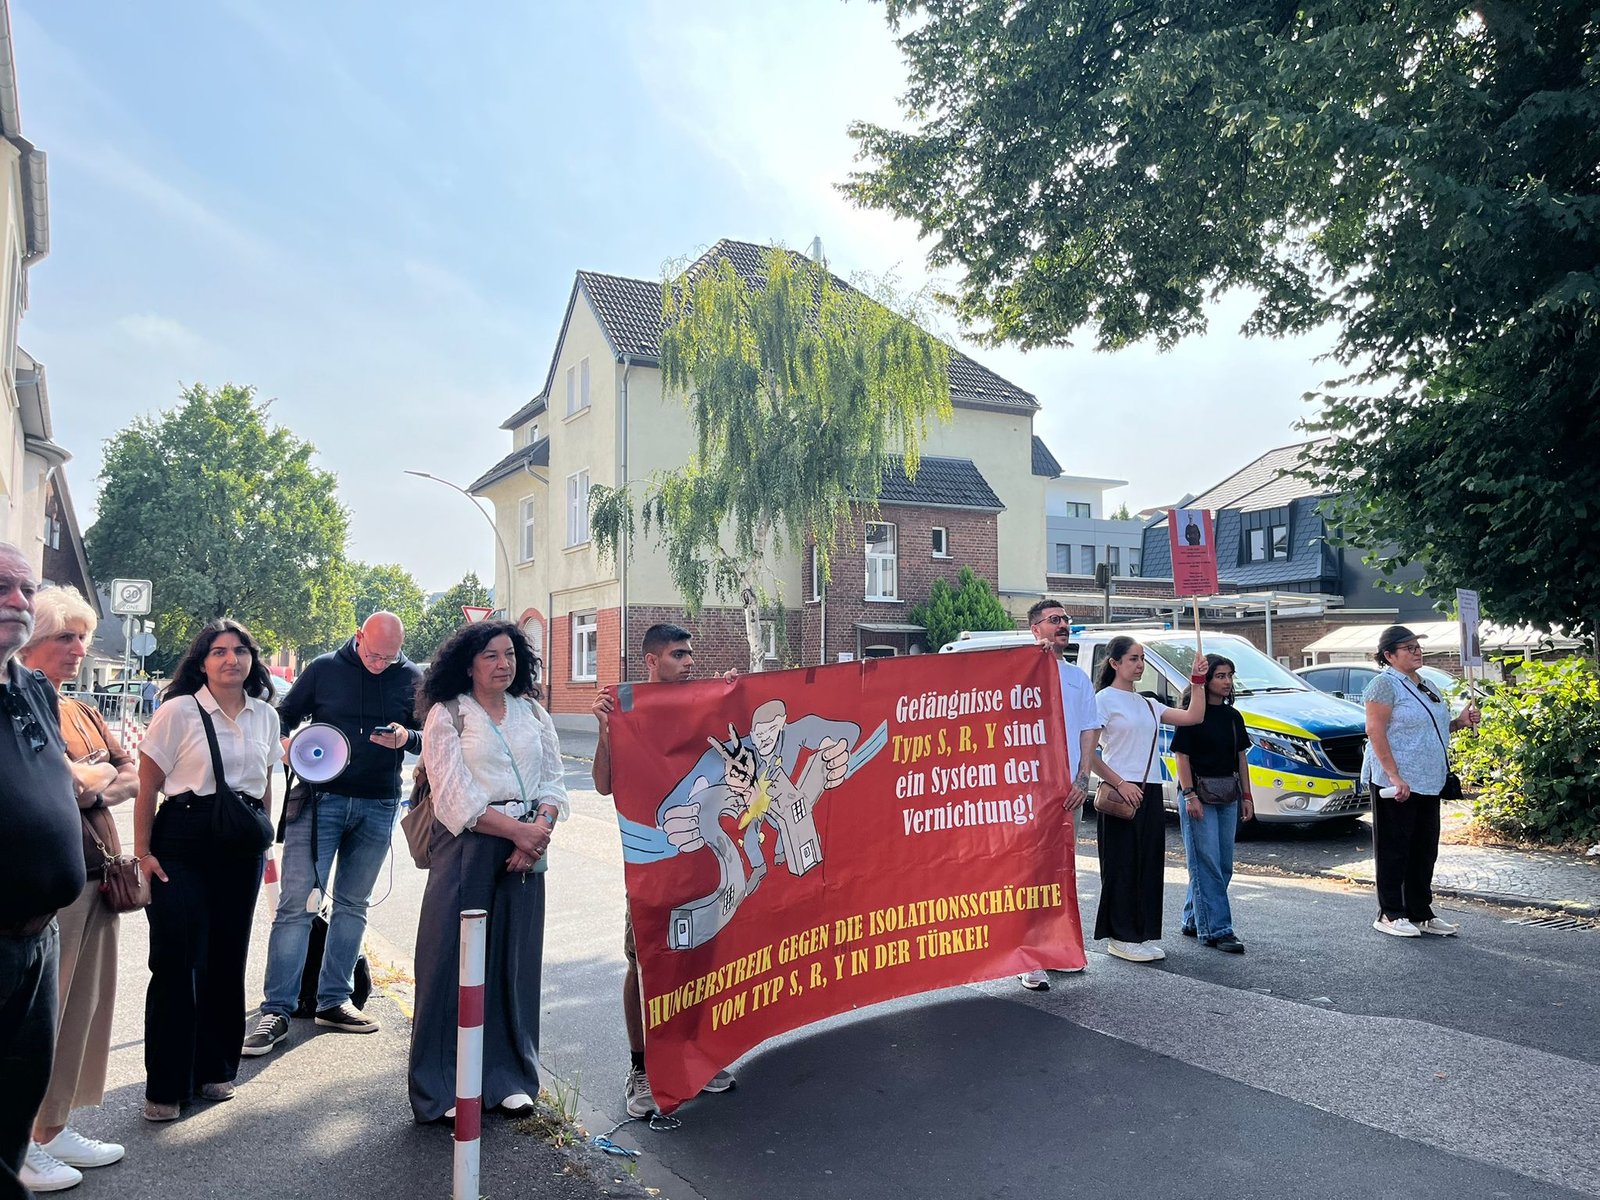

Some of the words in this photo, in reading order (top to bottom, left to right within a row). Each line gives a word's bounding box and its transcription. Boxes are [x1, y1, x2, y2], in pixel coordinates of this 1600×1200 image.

[125, 589, 139, 599] 30
[896, 688, 1003, 724] Gefängnisse
[1010, 684, 1042, 710] des
[892, 733, 932, 764] Typs
[937, 728, 952, 757] S,
[959, 725, 978, 753] R,
[985, 722, 997, 749] Y
[1003, 719, 1047, 747] sind
[895, 770, 925, 799] ein
[931, 762, 997, 795] System
[1004, 758, 1040, 785] der
[902, 793, 1035, 836] Vernichtung!
[648, 944, 773, 1030] HUNGERSTREIK
[778, 923, 830, 965] GEGEN
[835, 914, 863, 946] DIE
[868, 883, 1062, 937] ISOLATIONSSCHÄCHTE
[711, 991, 748, 1031] VOM
[752, 975, 784, 1012] TYP
[789, 969, 803, 997] S,
[809, 962, 828, 988] R,
[834, 954, 846, 981] Y
[851, 948, 868, 977] IN
[874, 939, 910, 970] DER
[916, 924, 989, 960] TÜRKEI!
